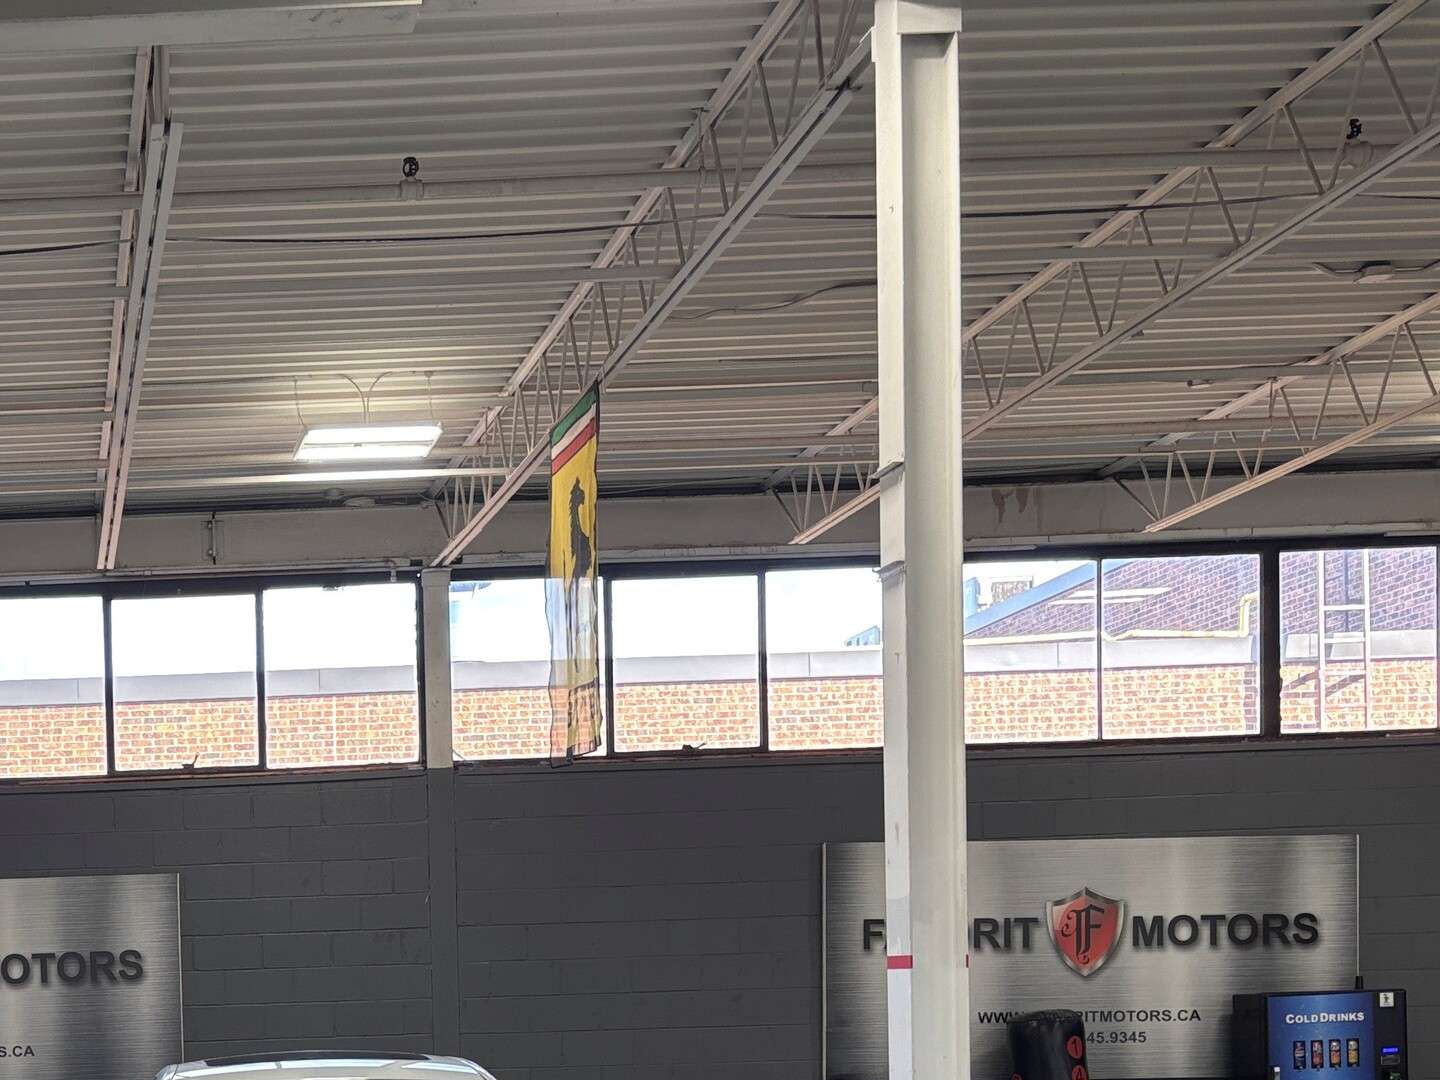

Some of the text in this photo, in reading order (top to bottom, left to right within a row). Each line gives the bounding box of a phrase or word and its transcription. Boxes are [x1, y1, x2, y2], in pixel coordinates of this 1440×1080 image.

[863, 912, 1319, 950] FRIT MOTORS
[1285, 1012, 1365, 1024] COLD DRINKS
